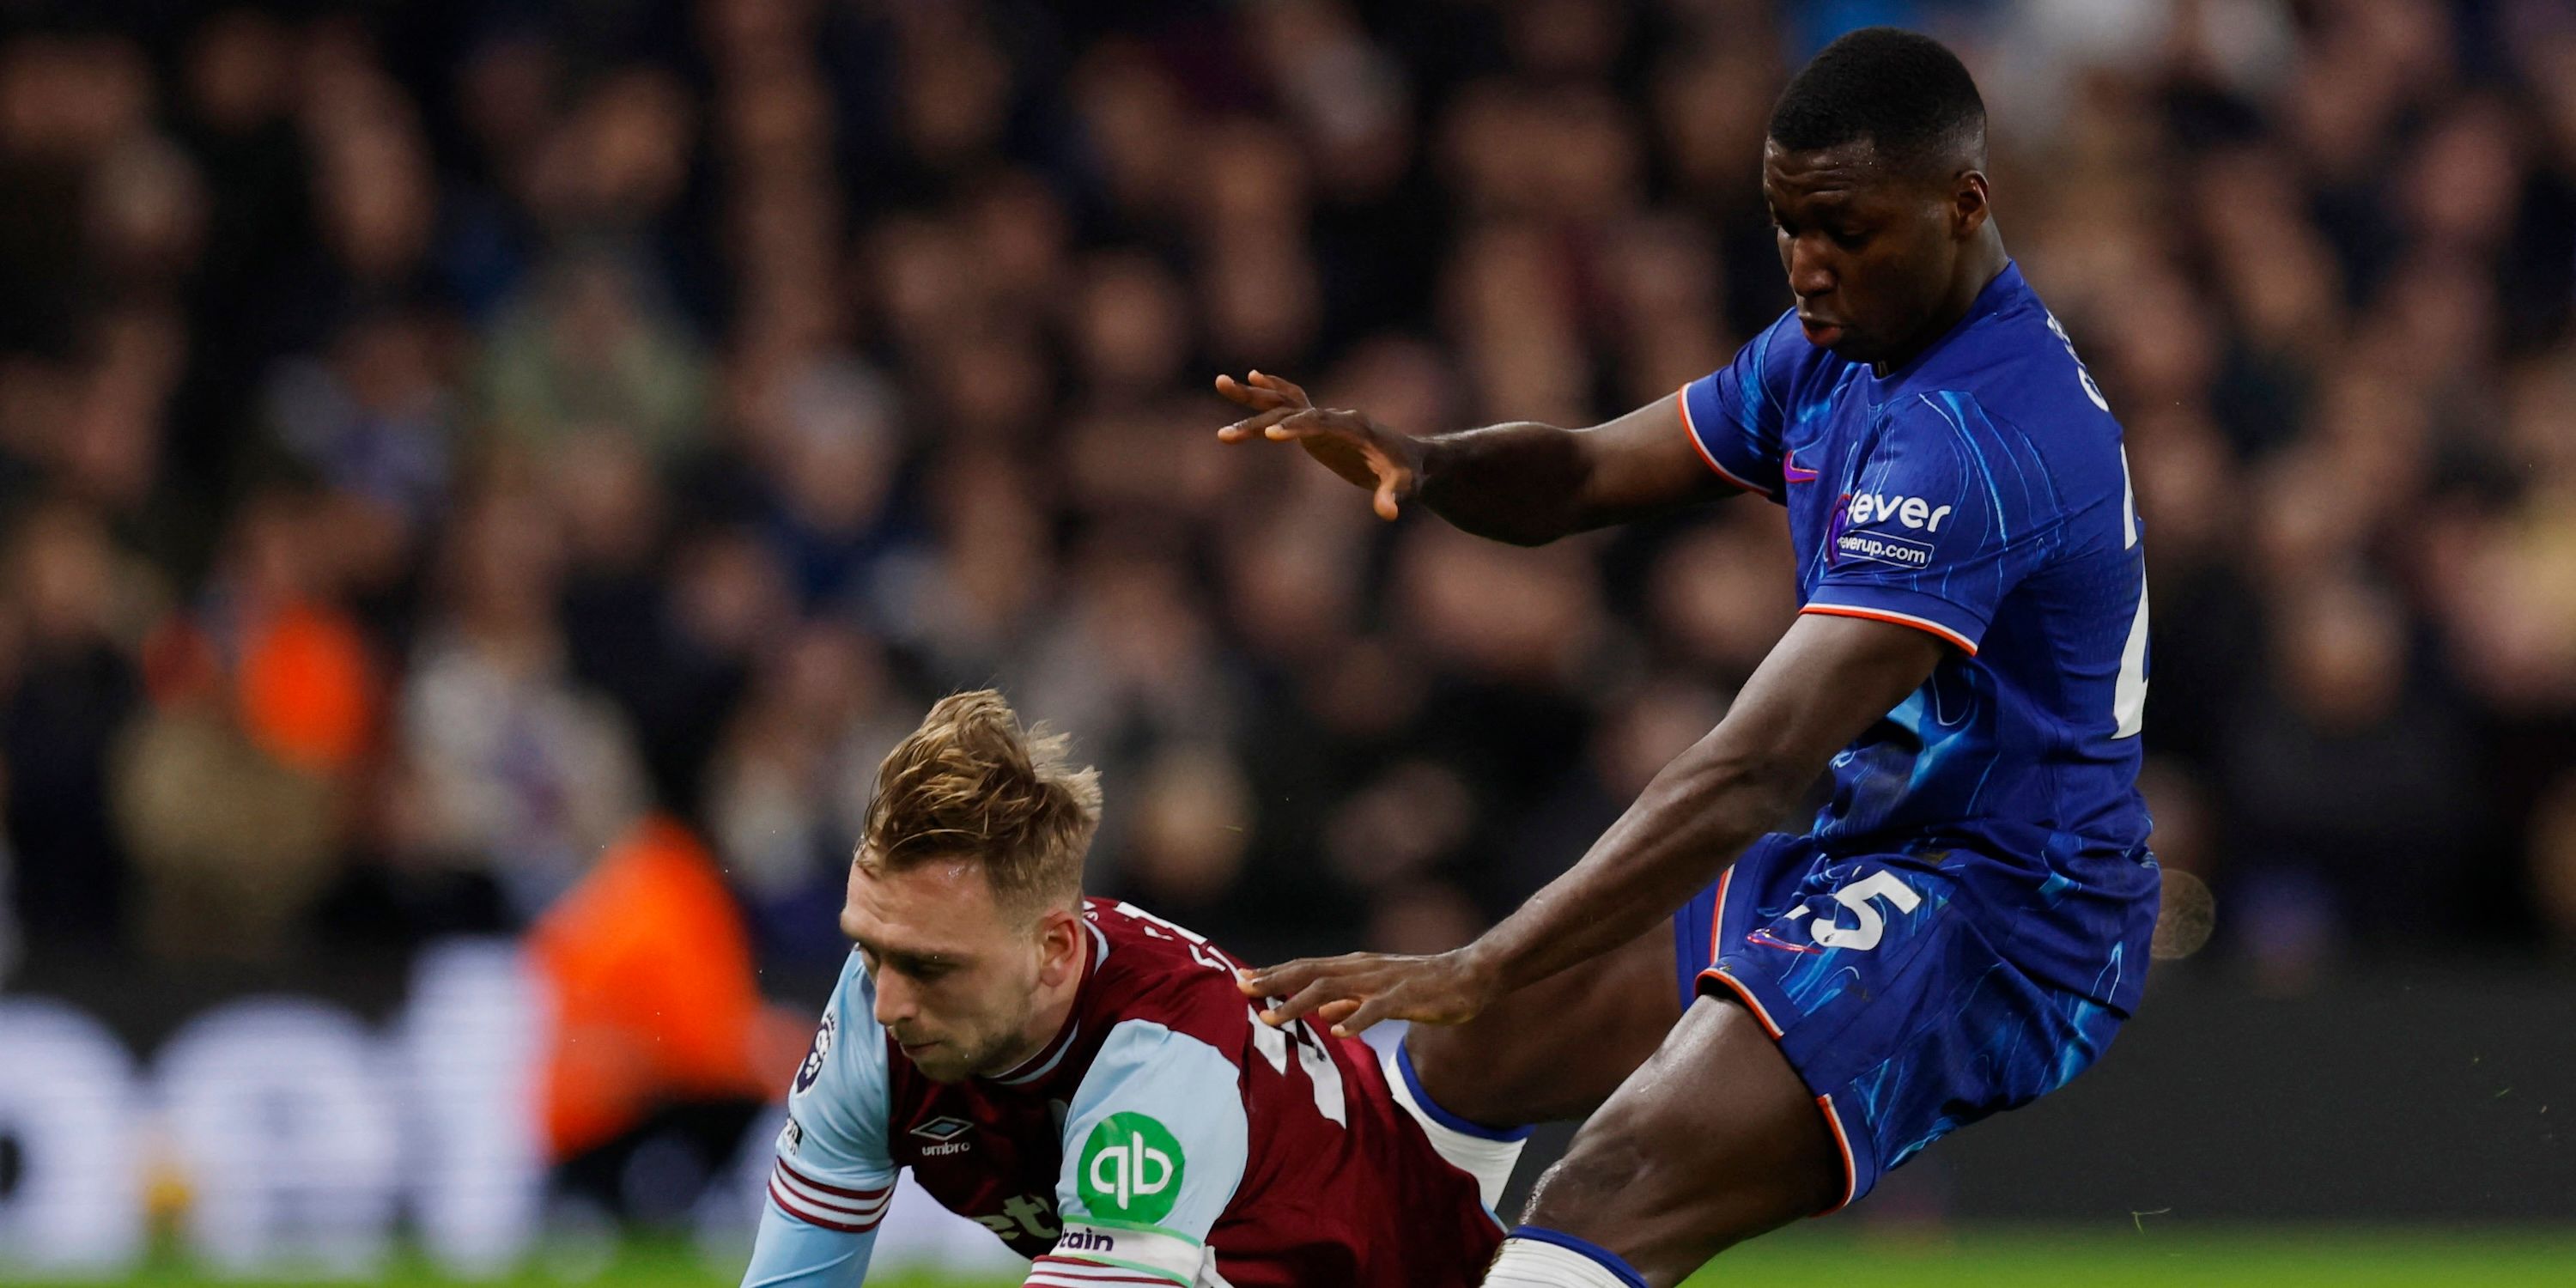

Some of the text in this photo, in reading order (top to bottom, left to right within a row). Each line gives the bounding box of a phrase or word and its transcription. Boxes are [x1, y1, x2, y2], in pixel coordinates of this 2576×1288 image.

[1837, 536, 1925, 563] everup.com
[1785, 870, 1922, 951] 5
[921, 1141, 971, 1157] umbro
[1090, 1131, 1174, 1211] qb
[974, 1193, 1061, 1240] et
[1060, 1226, 1114, 1252] tain
